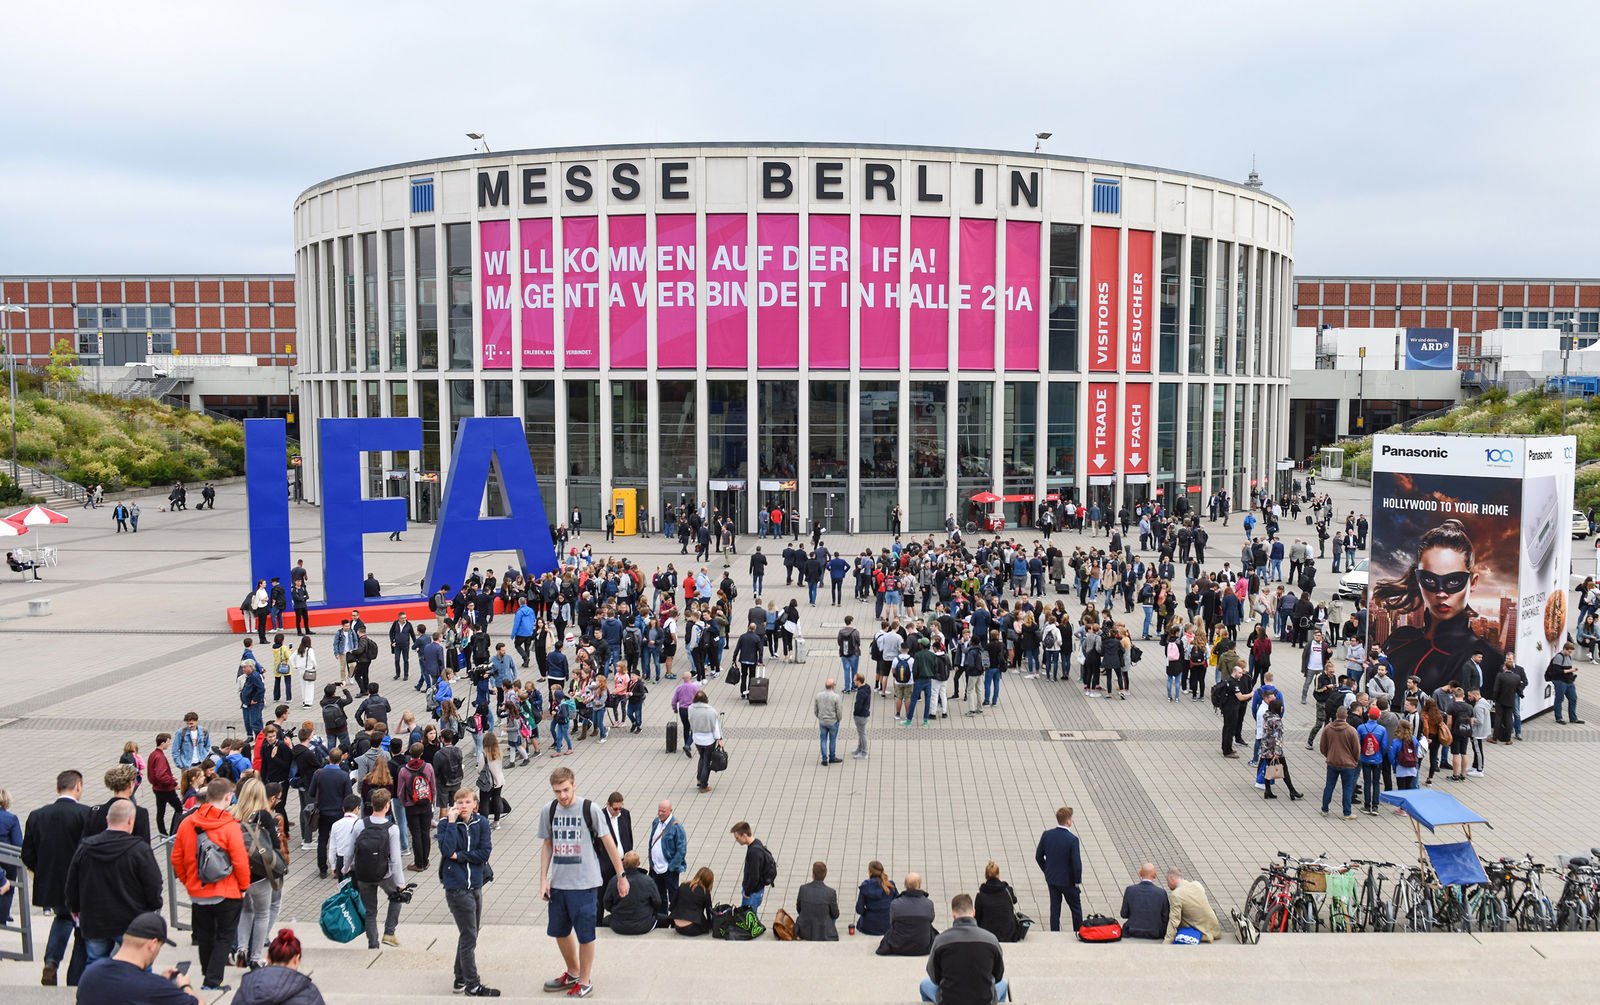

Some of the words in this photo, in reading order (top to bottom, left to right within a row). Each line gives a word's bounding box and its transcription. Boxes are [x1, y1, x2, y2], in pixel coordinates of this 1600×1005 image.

[478, 162, 690, 207] MESSE
[763, 161, 1039, 207] BERLIN
[484, 246, 695, 275] WILLKOMMEN
[712, 245, 773, 271] AUF
[783, 246, 849, 271] DER
[872, 247, 936, 273] IFA!
[632, 281, 827, 307] VERBINDET
[841, 282, 875, 308] IN
[885, 283, 972, 309] HALLE
[981, 285, 1033, 311] 21A
[1097, 282, 1109, 364] VISITORS
[1132, 272, 1143, 365] BESUCHER
[1421, 343, 1443, 351] ARD
[1096, 389, 1107, 448] TRADE
[1132, 404, 1142, 448] FACH
[1381, 445, 1449, 459] Panasonic
[1485, 449, 1513, 462] 100
[1528, 449, 1552, 460] Panasonic
[244, 417, 559, 612] IFA
[1383, 498, 1437, 511] HOLLYWOOD
[1440, 501, 1451, 512] TO
[1454, 502, 1478, 514] YOUR
[1482, 504, 1509, 516] HOME
